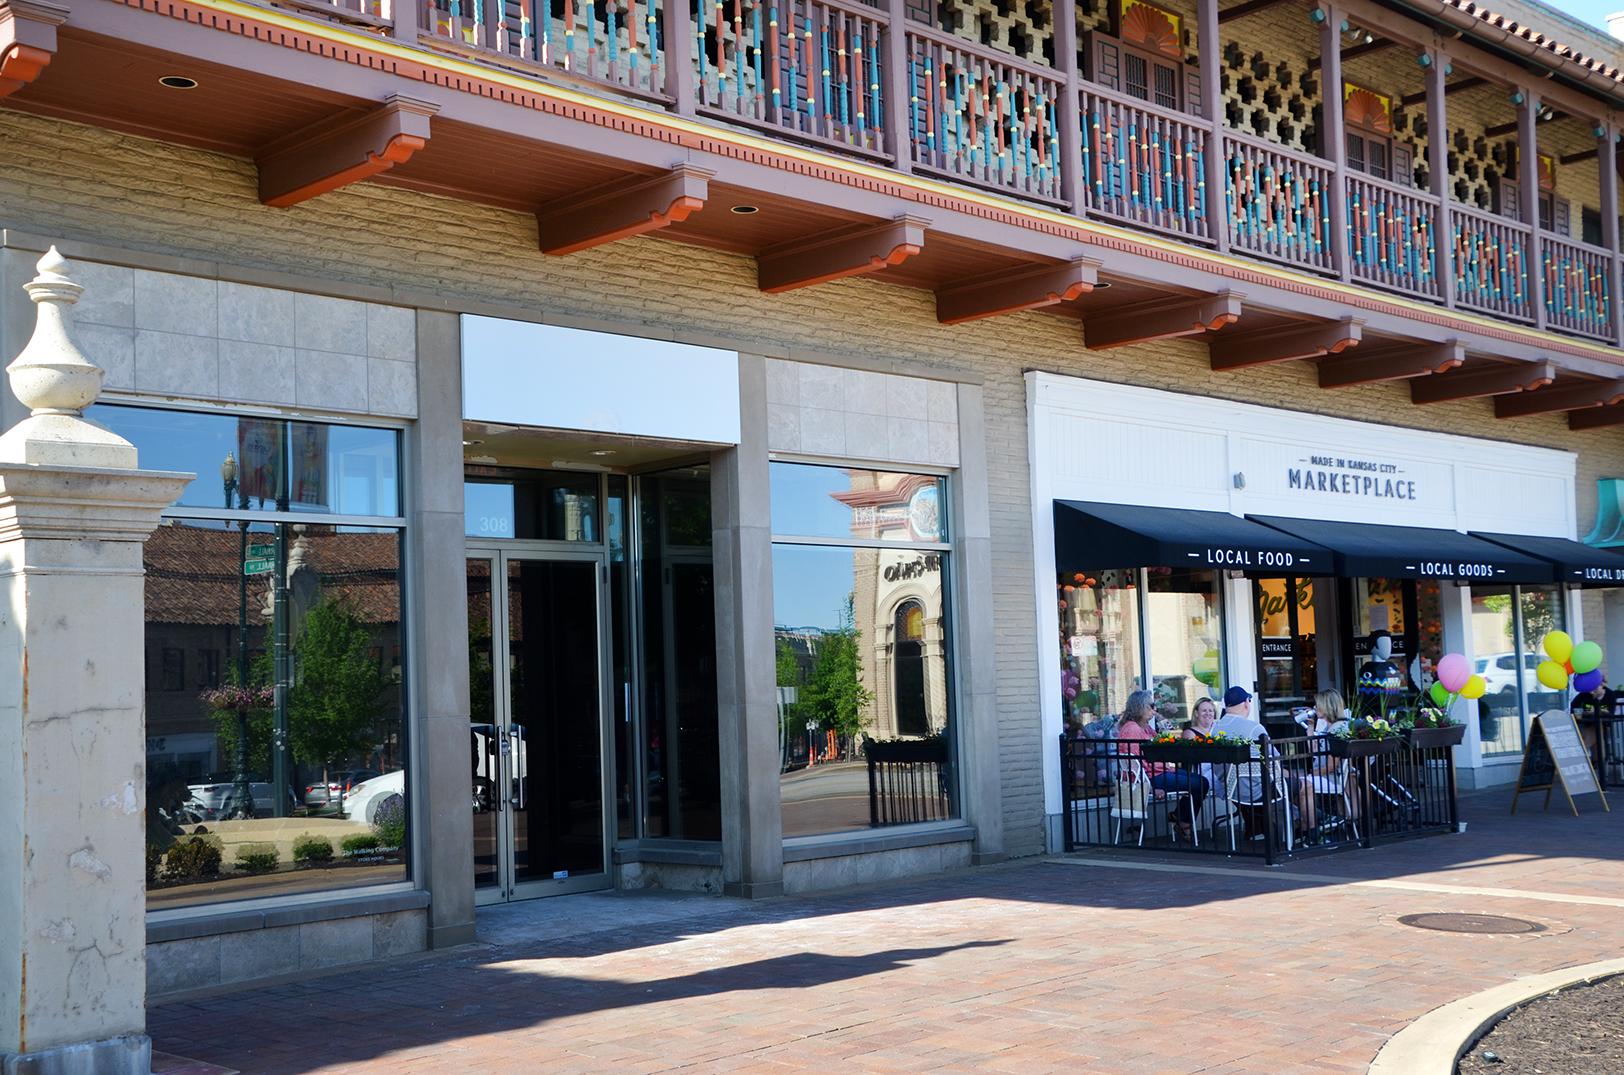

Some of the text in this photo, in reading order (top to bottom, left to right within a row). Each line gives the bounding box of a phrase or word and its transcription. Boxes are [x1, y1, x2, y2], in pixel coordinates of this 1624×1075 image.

[1310, 455, 1397, 474] MADE IN KANSAS CITY
[1288, 468, 1416, 500] MARKETPLACE
[479, 516, 508, 533] 308
[1207, 549, 1293, 567] LOCAL FOOD
[1420, 562, 1493, 577] LOCAL GOODS
[1585, 568, 1613, 580] LOCAL
[1262, 643, 1292, 652] ENTRANCE
[1355, 641, 1404, 650] ENCE
